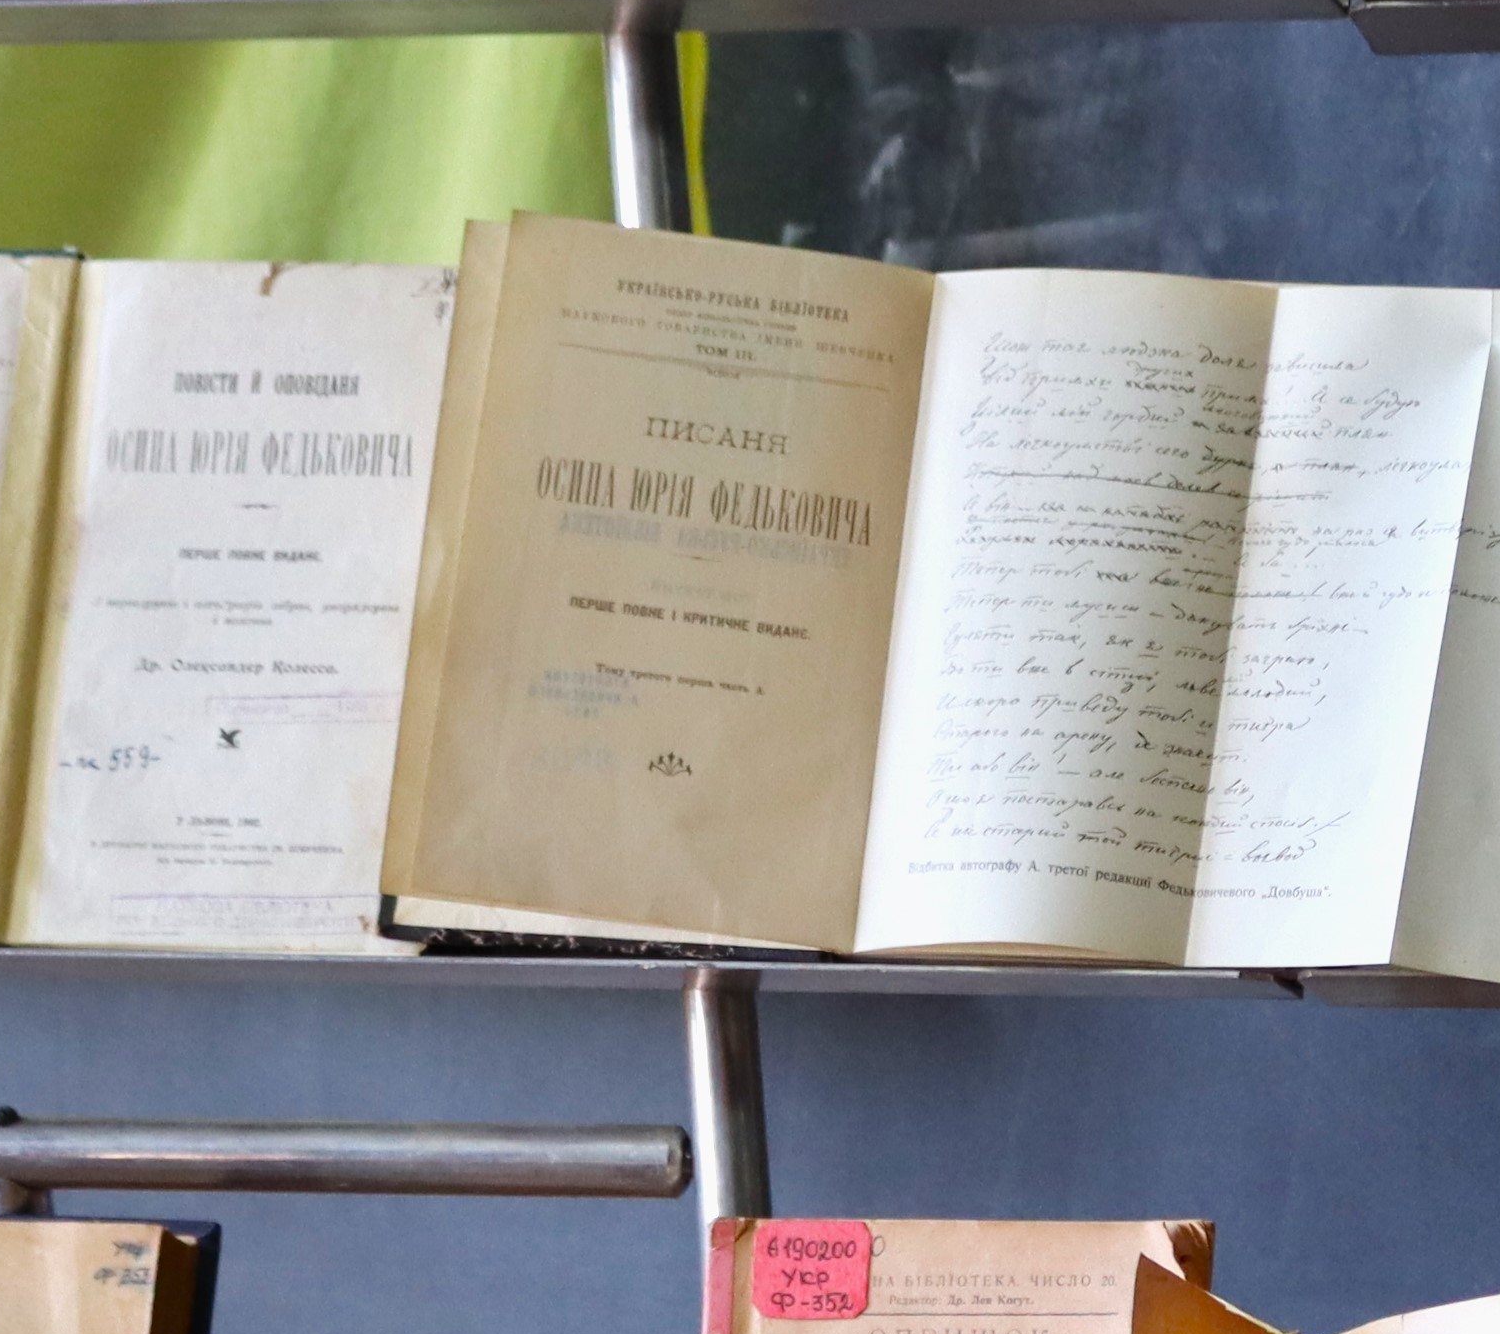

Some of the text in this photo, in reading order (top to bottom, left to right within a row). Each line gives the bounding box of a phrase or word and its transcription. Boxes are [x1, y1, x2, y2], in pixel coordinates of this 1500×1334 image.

[646, 417, 790, 455] ПИСАНЯ
[537, 456, 871, 547] ОСИПА ЮРІЯ ФЕДЬКОВИЧА
